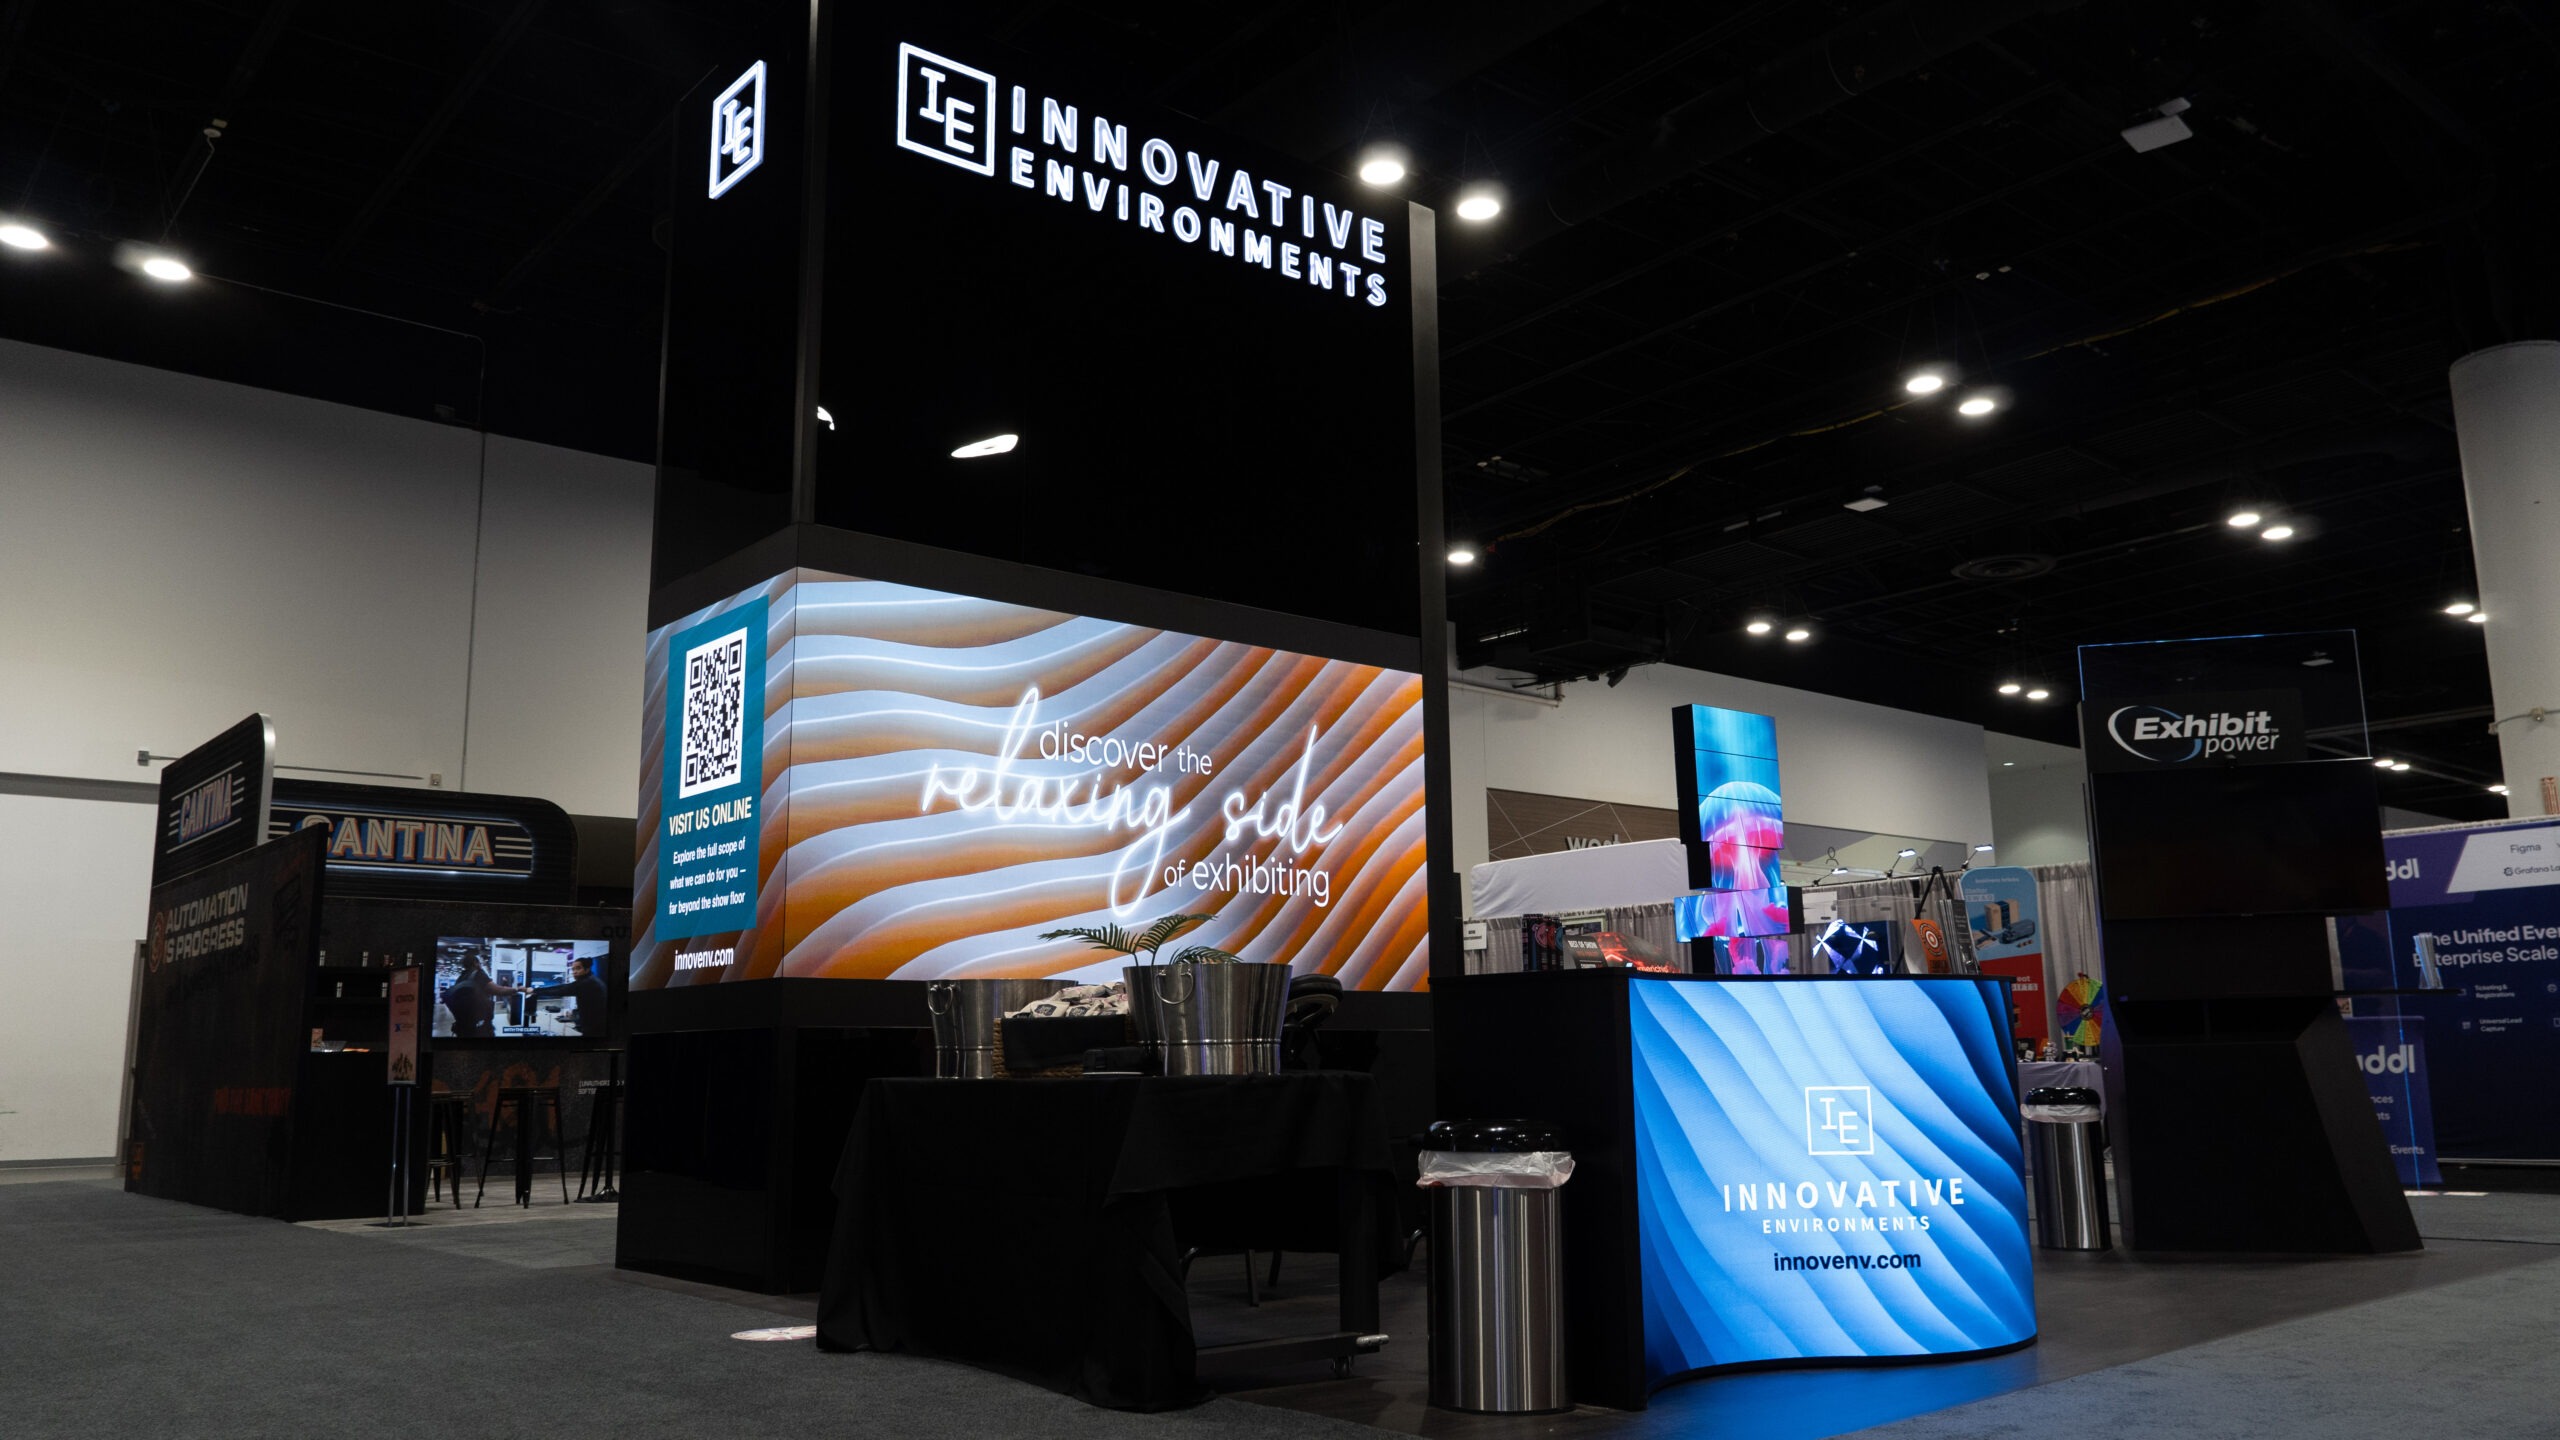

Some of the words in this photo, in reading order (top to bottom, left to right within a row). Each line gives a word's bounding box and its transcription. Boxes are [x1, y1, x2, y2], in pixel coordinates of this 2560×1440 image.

[920, 66, 975, 154] IE
[1012, 85, 1386, 264] INNOVATIVE
[1011, 146, 1388, 307] ENVIRONMENTS
[2134, 711, 2272, 740] Exhibit
[1039, 720, 1168, 773] discover
[1178, 746, 1212, 775] the
[2205, 734, 2280, 758] power
[179, 773, 232, 842] CANTINA
[668, 812, 694, 836] VISIT
[695, 807, 710, 830] US
[712, 796, 752, 826] ONLINE
[921, 686, 1191, 917] relaxing
[1223, 724, 1343, 854] side
[673, 851, 696, 866] Explore
[696, 848, 706, 859] the
[707, 842, 718, 858] full
[718, 842, 738, 857] scope
[738, 836, 746, 850] of
[2510, 844, 2541, 854] Figma
[670, 876, 684, 890] what
[684, 876, 694, 887] we
[694, 874, 706, 885] can
[706, 870, 714, 883] do
[715, 868, 726, 882] for
[726, 866, 738, 883] you
[1164, 859, 1186, 888] of
[1192, 853, 1330, 908] exhibiting
[2514, 865, 2549, 876] Grafana
[166, 882, 248, 934] AUTOMATION
[668, 902, 678, 915] far
[678, 898, 700, 916] beyond
[701, 896, 711, 910] the
[712, 894, 728, 908] show
[730, 891, 746, 904] floor
[176, 917, 245, 961] PROGRESS
[2454, 926, 2520, 945] Unified
[2522, 925, 2560, 940] Eve
[674, 948, 734, 971] innovenv.com
[2412, 949, 2504, 968] Eterprise
[2506, 946, 2558, 962] Scale
[1820, 1098, 1860, 1144] IE
[2390, 1144, 2424, 1155] Events
[1724, 1178, 1964, 1212] INNOVATIVE
[1762, 1216, 1930, 1234] ENVIRONMENTS
[1774, 1252, 1922, 1272] innovenv.com
